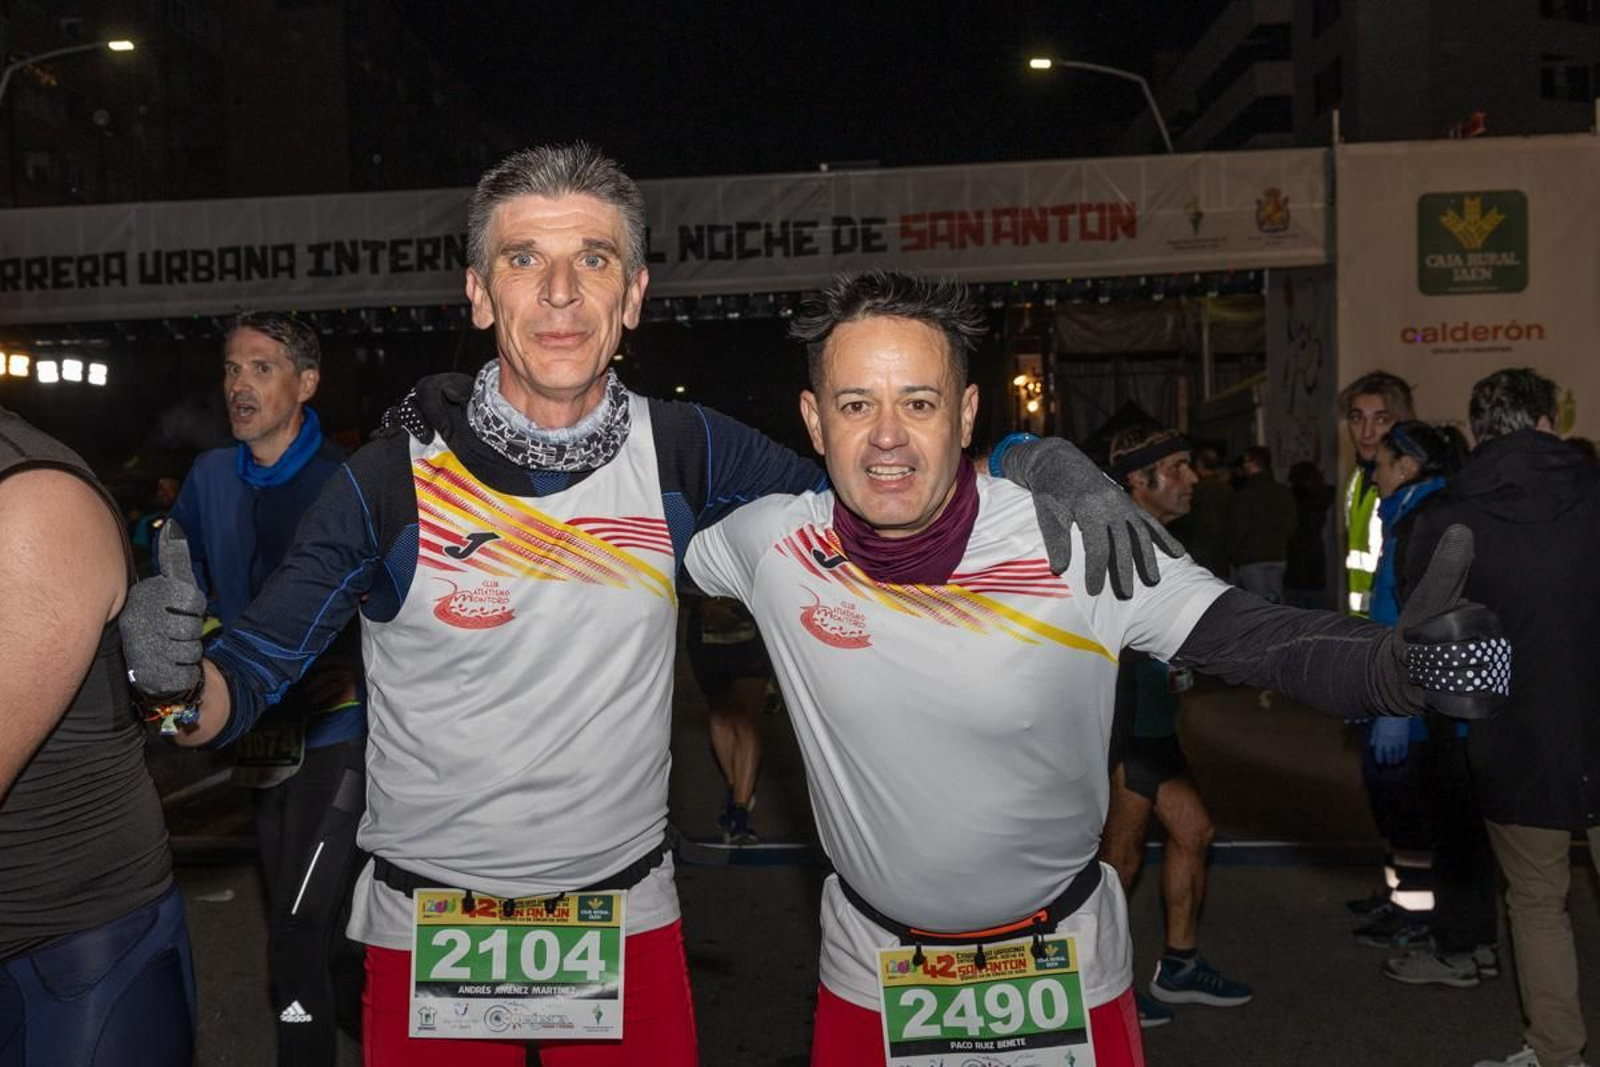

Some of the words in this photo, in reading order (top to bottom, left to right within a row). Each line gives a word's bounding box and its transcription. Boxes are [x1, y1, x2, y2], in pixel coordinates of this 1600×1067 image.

[138, 243, 295, 285] URBANA
[678, 219, 818, 262] NOCHE
[832, 215, 886, 255] DE
[900, 211, 984, 252] SAN
[990, 203, 1135, 246] ANTON
[1400, 319, 1546, 344] calderón
[429, 929, 606, 981] 2104
[922, 954, 957, 979] 42
[458, 984, 491, 995] ANDRÉS
[279, 1013, 313, 1023] adidas
[899, 978, 1069, 1039] 2490
[950, 1040, 973, 1050] PACO
[975, 1040, 995, 1050] RUIZ
